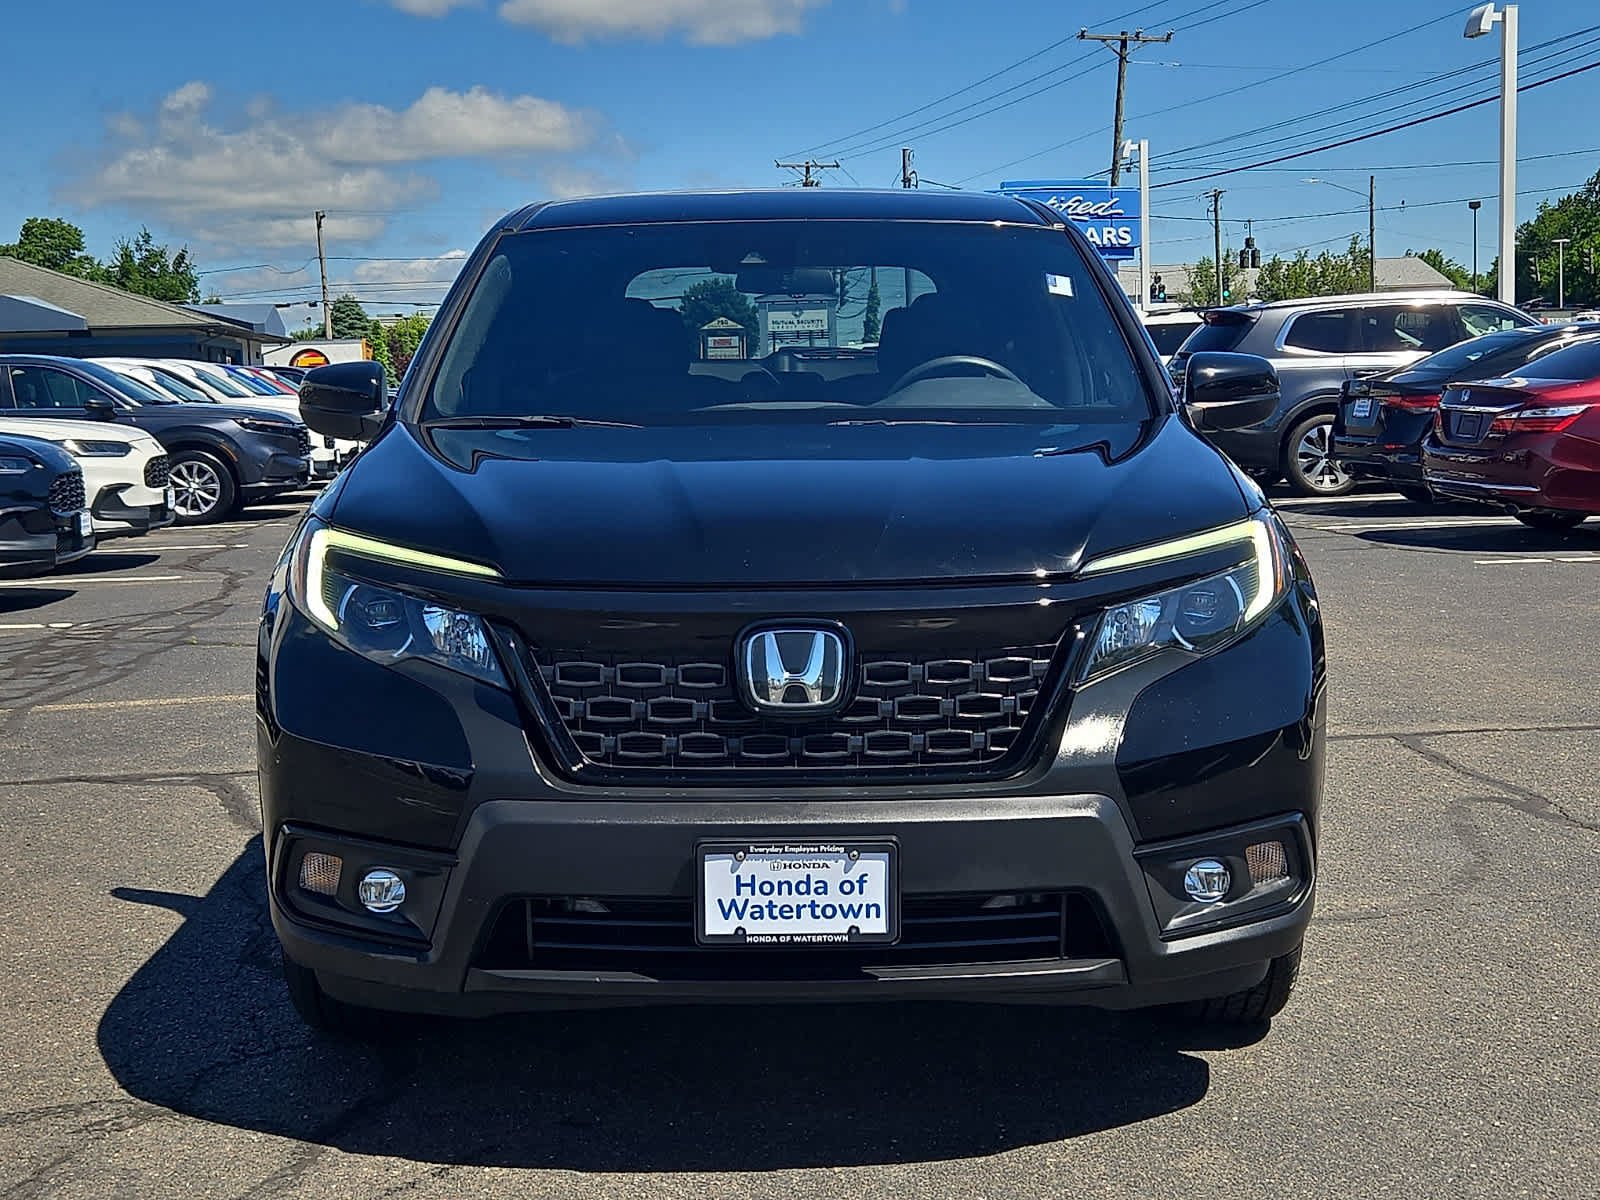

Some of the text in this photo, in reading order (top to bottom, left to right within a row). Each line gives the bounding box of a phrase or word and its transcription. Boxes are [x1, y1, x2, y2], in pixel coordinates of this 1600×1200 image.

[749, 846, 783, 854] Everyday
[735, 873, 868, 896] Honda of
[717, 898, 881, 920] Watertown
[746, 935, 849, 943] HONDA OF WATERTOWN
